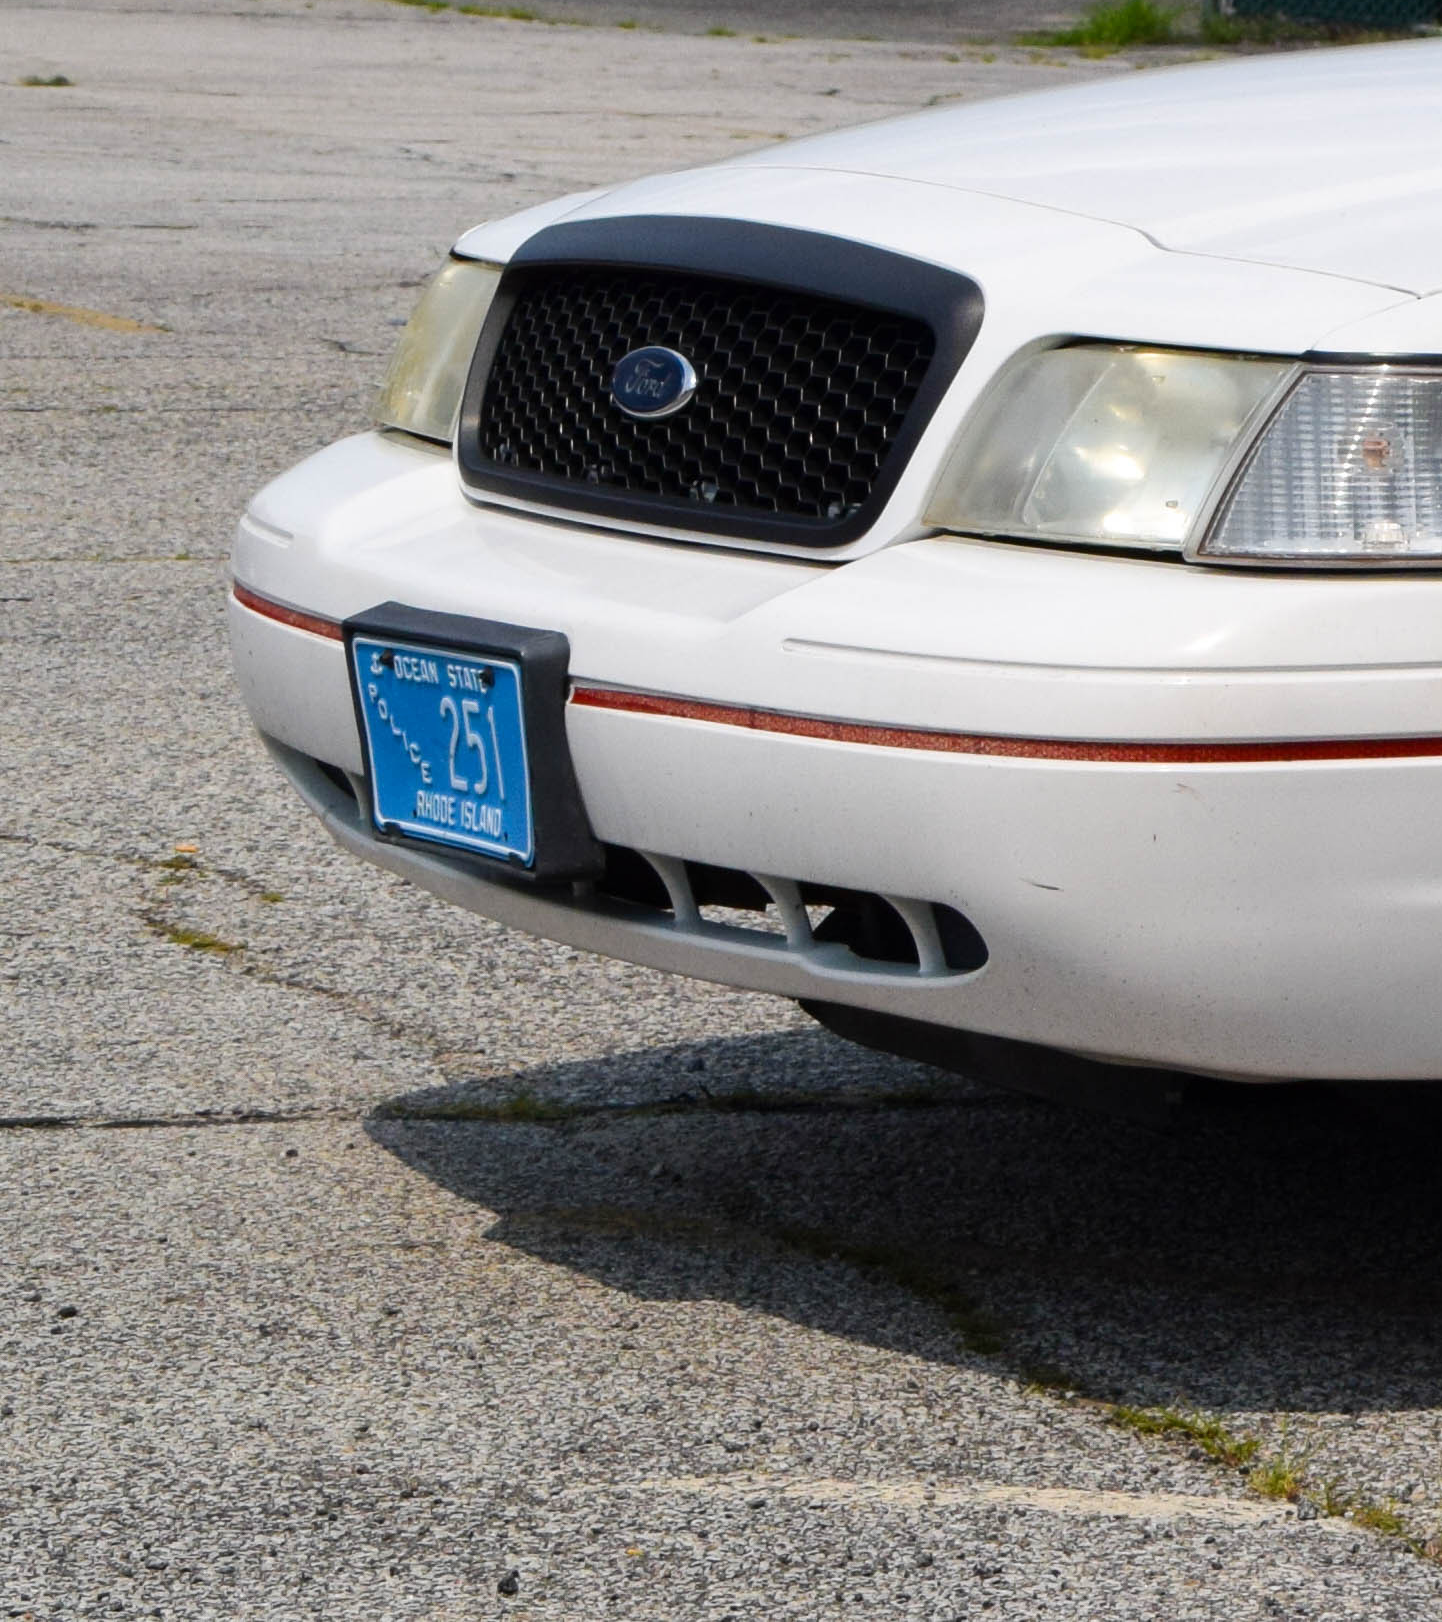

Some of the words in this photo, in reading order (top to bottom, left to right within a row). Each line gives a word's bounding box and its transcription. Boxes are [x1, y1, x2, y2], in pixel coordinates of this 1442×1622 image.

[394, 654, 439, 685] OCEAN
[368, 682, 433, 785] POLICE
[440, 695, 505, 802] 251
[416, 789, 456, 825] RHODE
[461, 801, 503, 837] ISLAND
